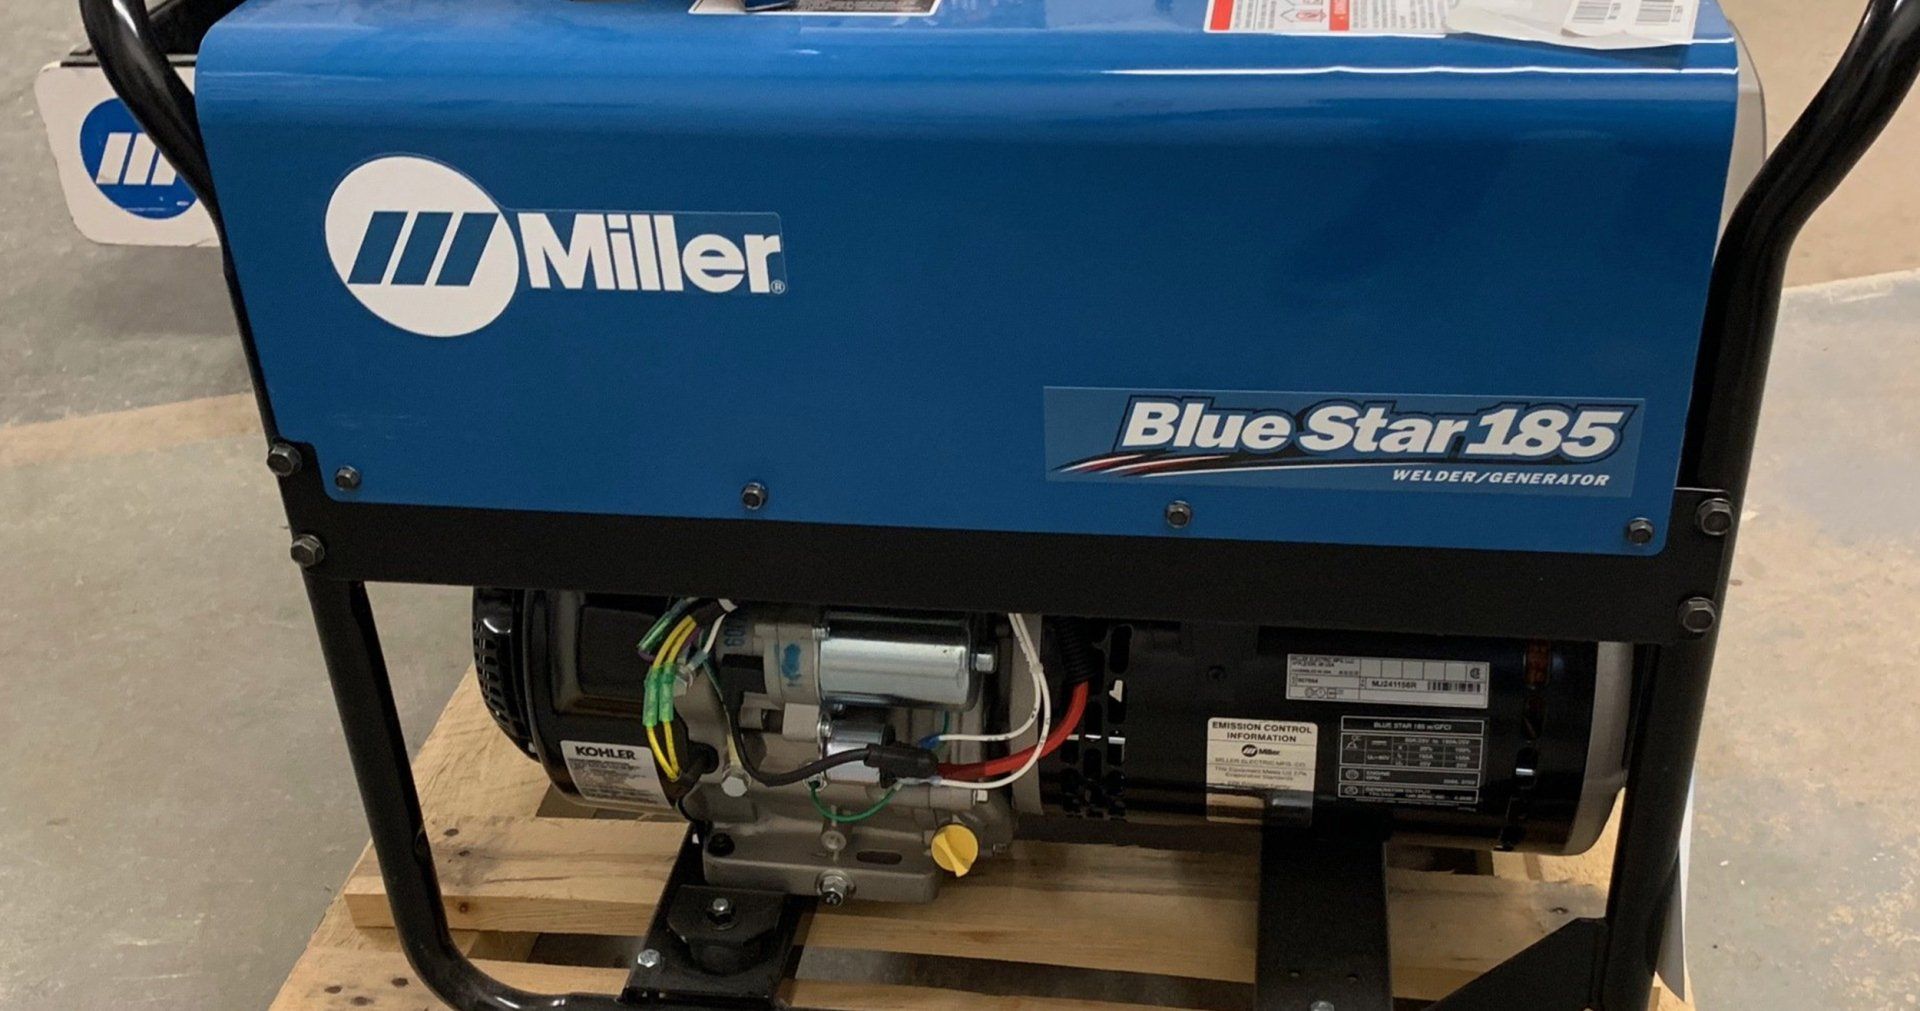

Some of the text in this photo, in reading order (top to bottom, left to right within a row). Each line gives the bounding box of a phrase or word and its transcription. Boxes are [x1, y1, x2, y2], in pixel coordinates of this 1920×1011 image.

[517, 212, 782, 294] Miller
[1122, 401, 1625, 458] Blue Star 185
[1392, 469, 1610, 487] WELDER/GENERATOR
[1212, 721, 1312, 734] EMISSION CONTROL
[1226, 732, 1297, 743] INFORMATION
[574, 745, 637, 760] KOHLER
